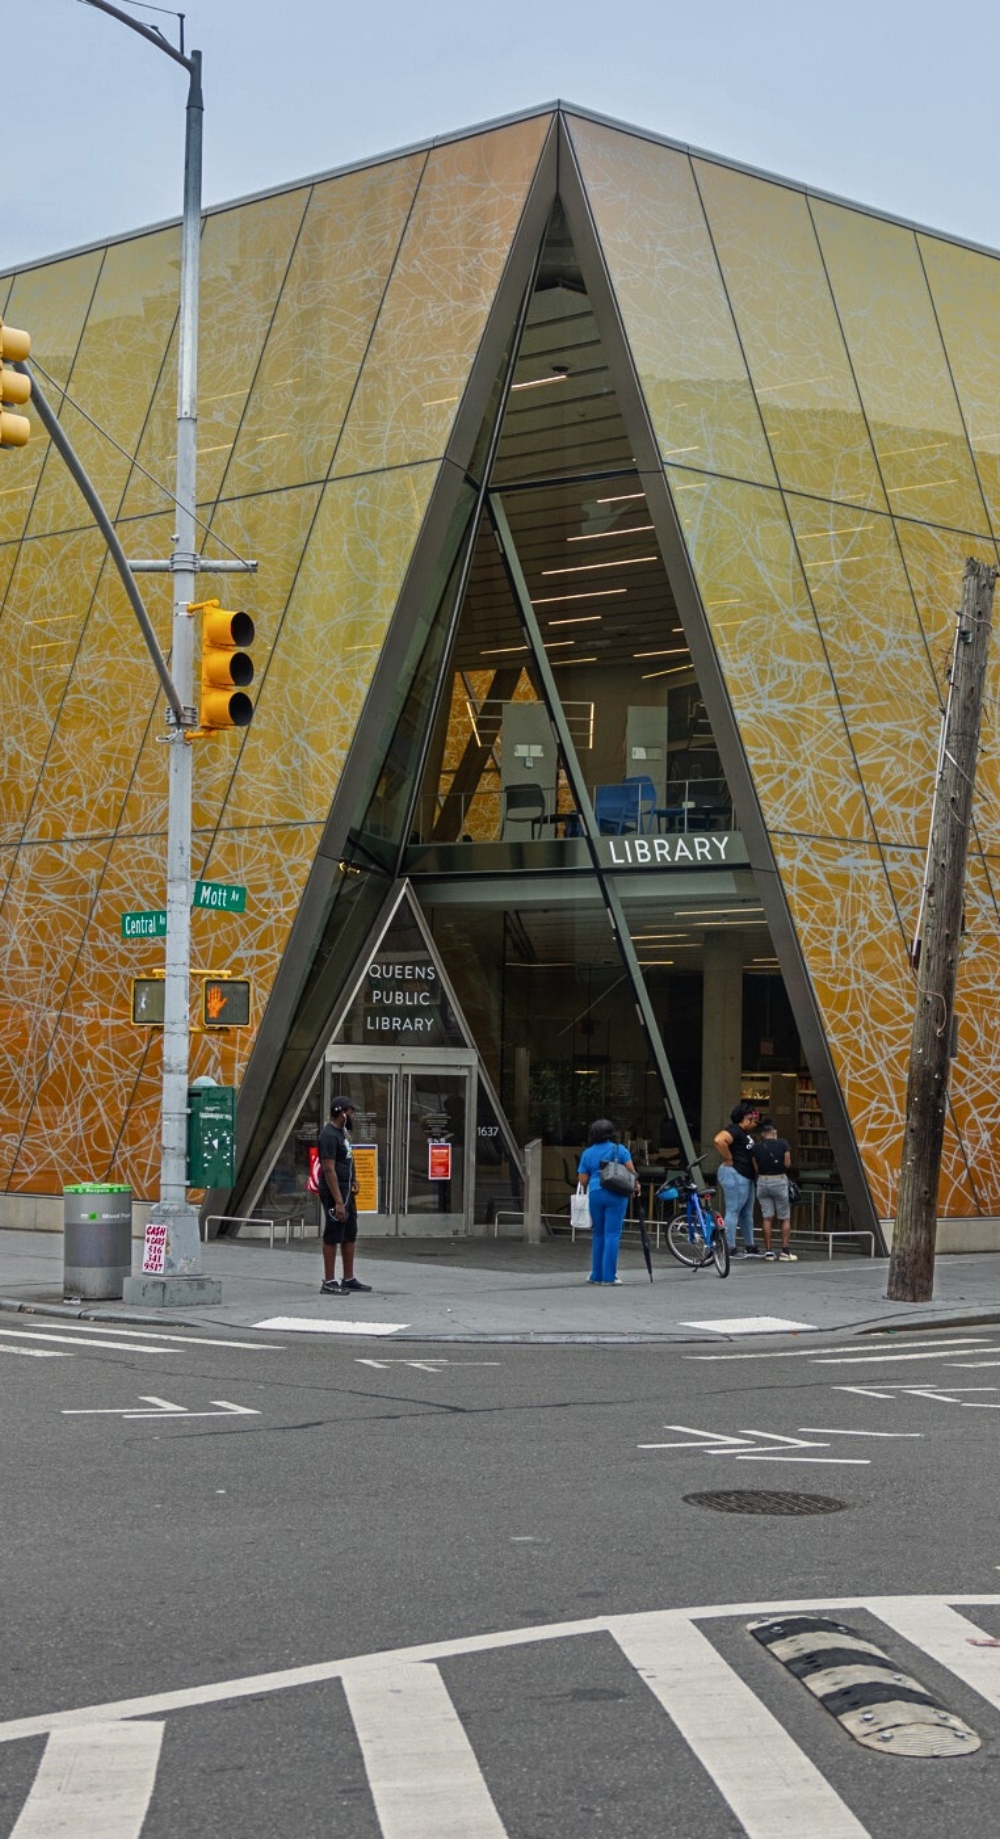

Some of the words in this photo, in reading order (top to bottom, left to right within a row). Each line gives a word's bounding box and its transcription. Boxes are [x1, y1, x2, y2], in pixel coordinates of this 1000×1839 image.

[609, 836, 729, 863] LIBRARY
[200, 885, 227, 907] Mott
[230, 890, 240, 902] Av
[125, 915, 157, 935] Central
[369, 964, 435, 980] QUEENS
[373, 990, 430, 1005] PUBLIC
[367, 1016, 434, 1031] LIBRARY
[477, 1126, 499, 1136] 1637
[146, 1225, 166, 1236] CASH
[148, 1245, 162, 1254] 516
